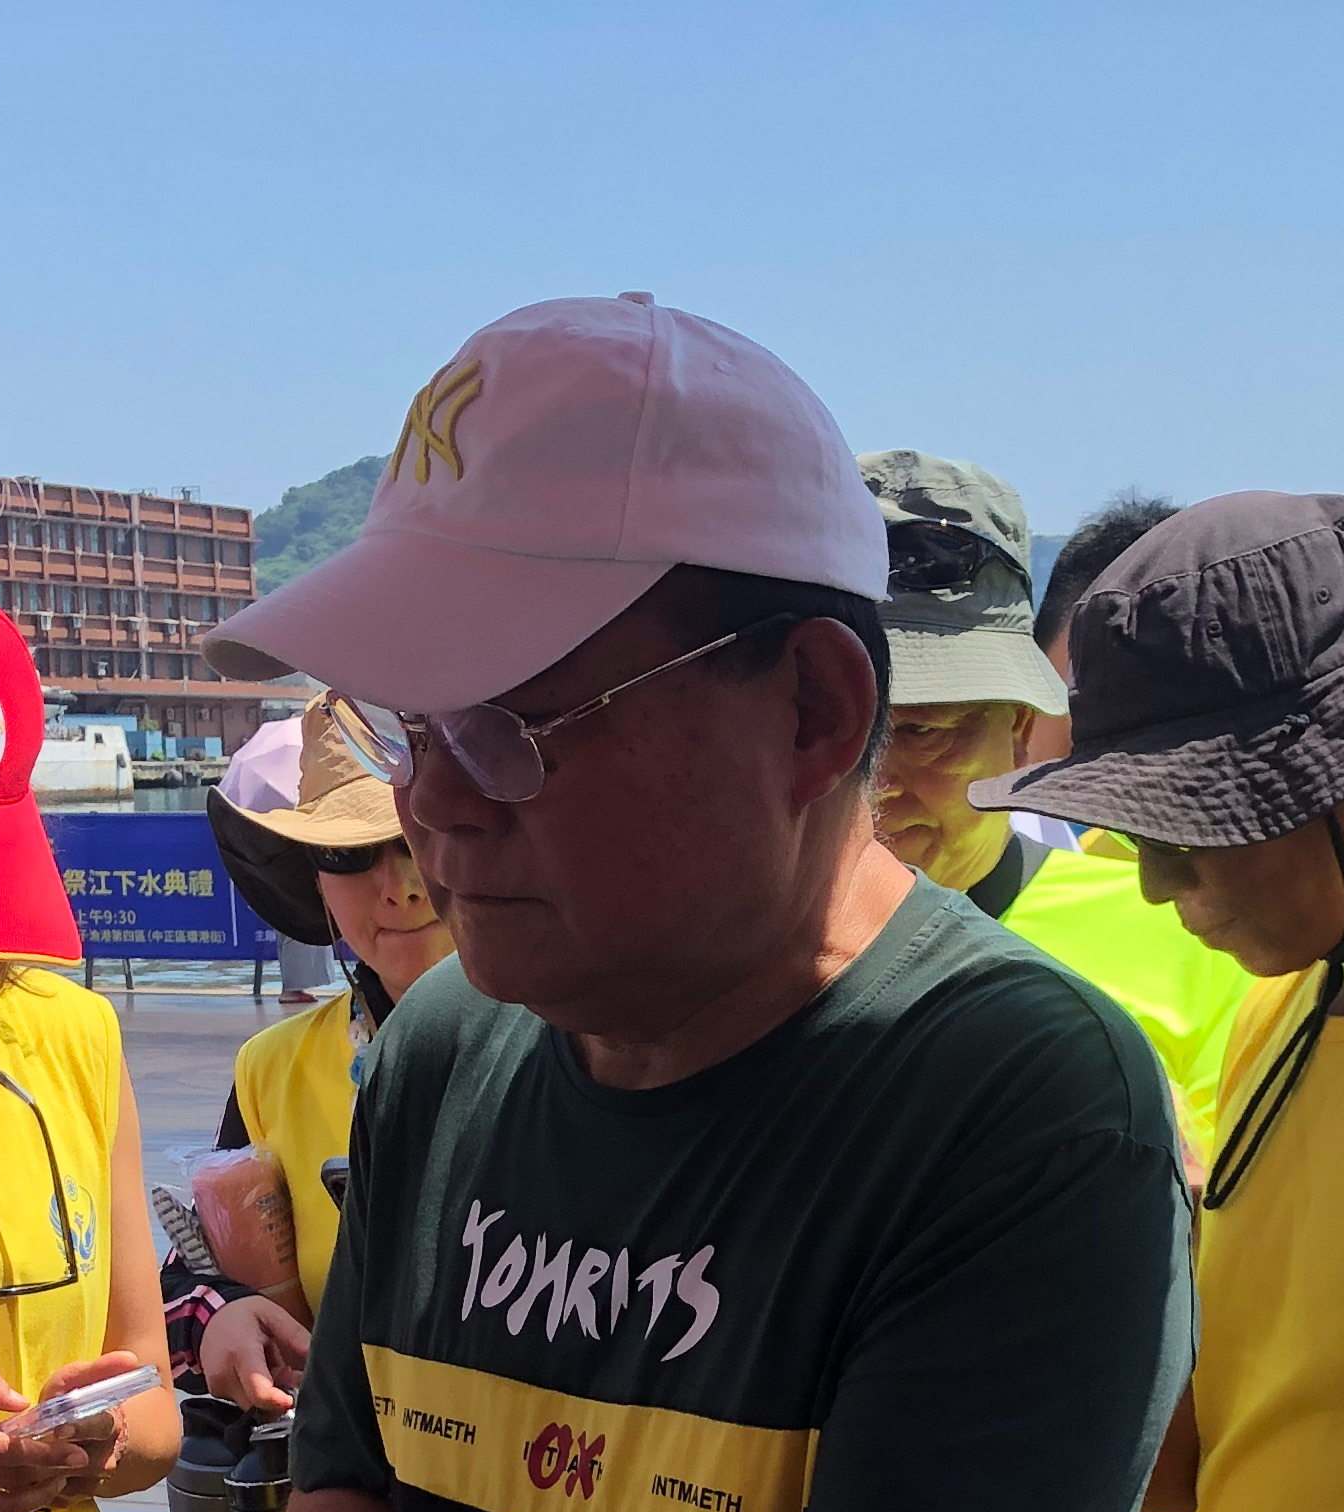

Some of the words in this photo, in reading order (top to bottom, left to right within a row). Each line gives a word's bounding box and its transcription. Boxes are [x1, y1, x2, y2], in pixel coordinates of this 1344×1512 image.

[63, 868, 215, 897] 祭江下水典禮
[403, 1407, 476, 1445] INTMAETH
